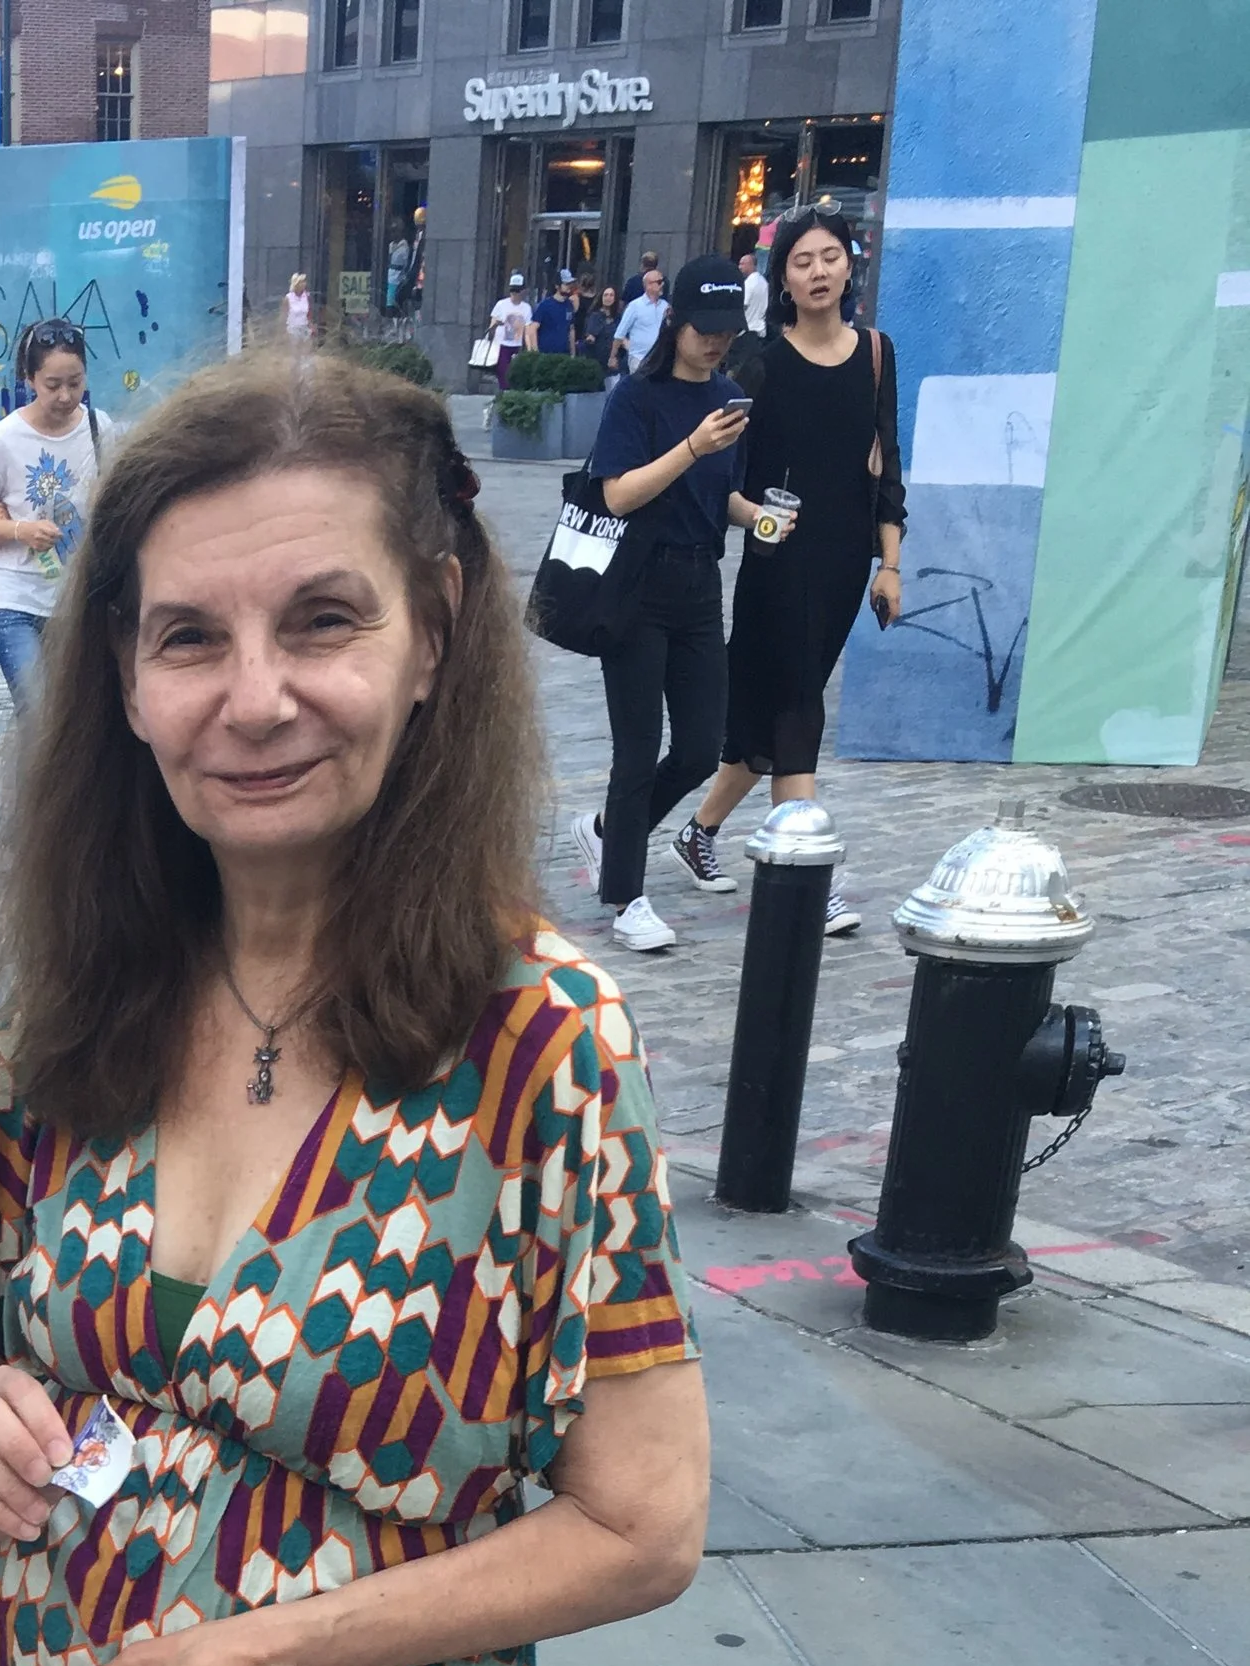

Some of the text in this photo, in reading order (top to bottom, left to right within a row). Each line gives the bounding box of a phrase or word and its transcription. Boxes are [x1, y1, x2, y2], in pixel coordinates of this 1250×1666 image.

[463, 72, 578, 131] Superdry
[78, 218, 157, 245] us open
[559, 502, 629, 539] NEW YORK
